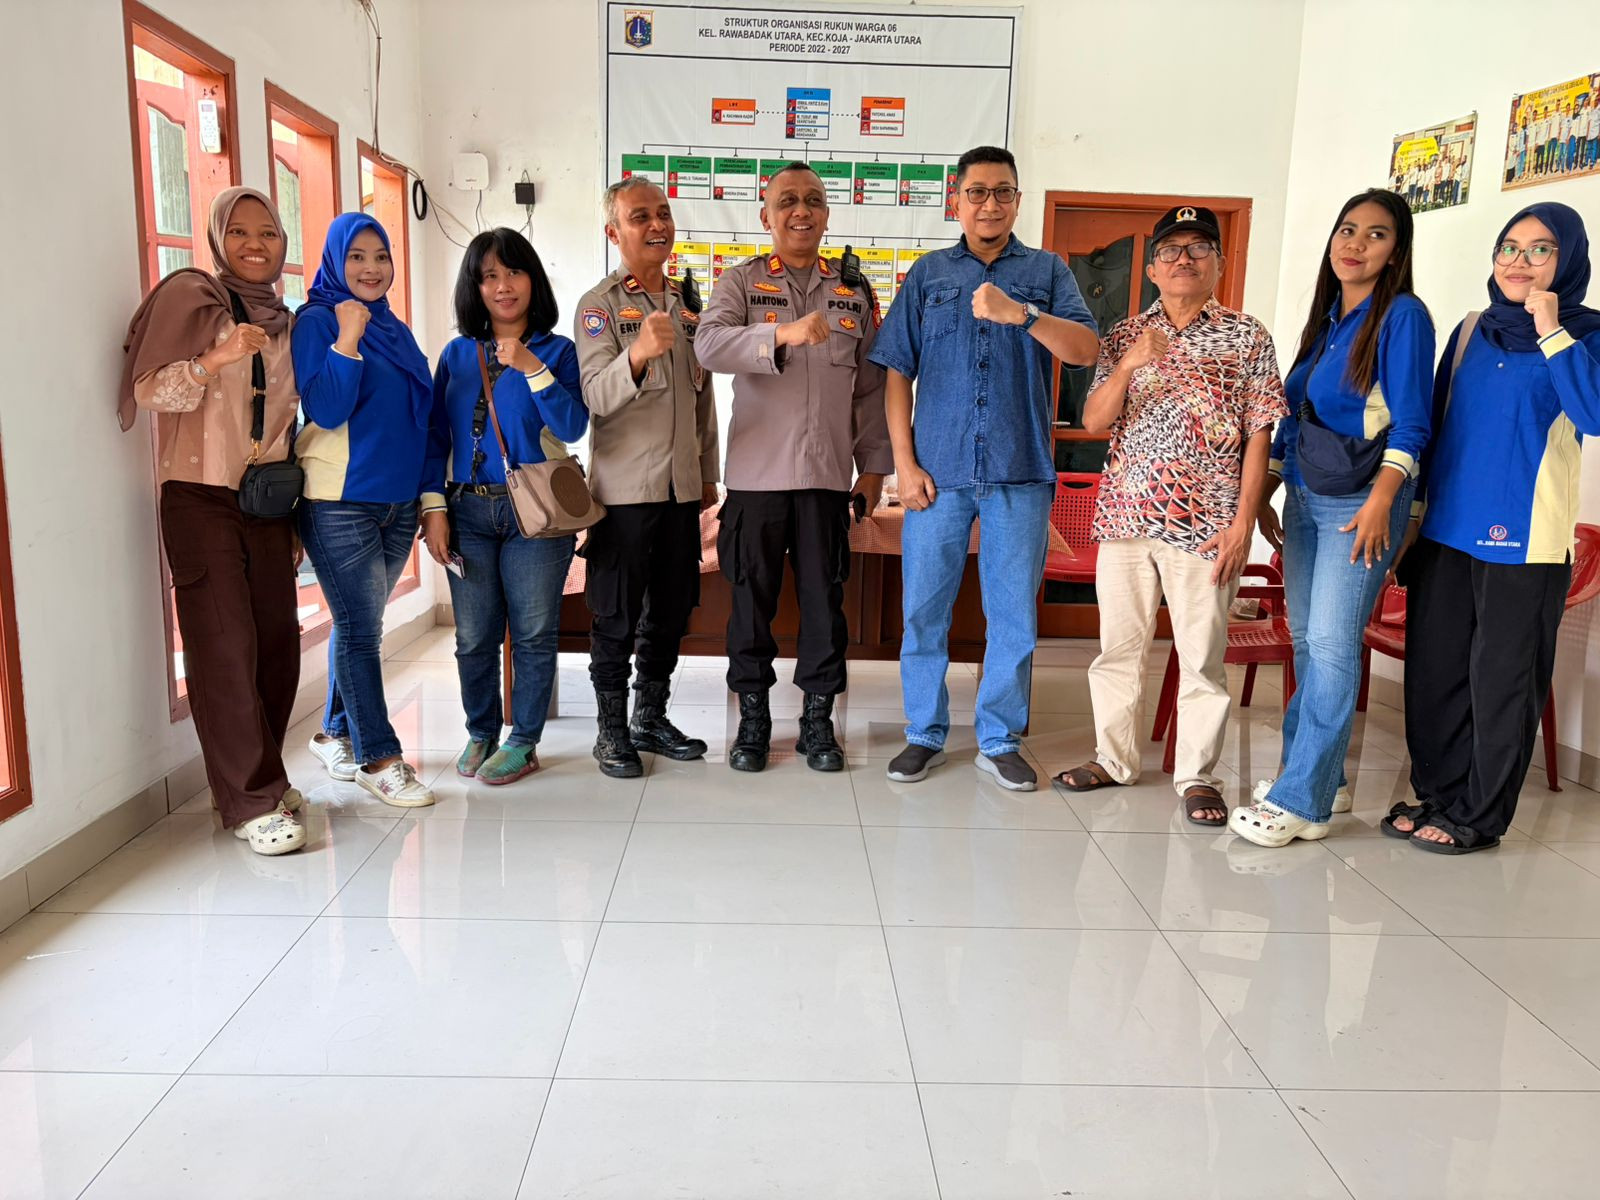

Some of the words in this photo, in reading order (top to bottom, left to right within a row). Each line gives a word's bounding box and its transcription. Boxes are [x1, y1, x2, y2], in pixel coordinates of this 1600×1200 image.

[724, 17, 769, 28] STRUKTUR
[772, 19, 822, 30] ORGANISASI
[824, 21, 853, 31] RUKUN
[855, 22, 886, 32] WARGA
[887, 23, 897, 32] 06
[698, 28, 718, 38] KEL.
[719, 29, 773, 40] RAWABADAK
[774, 31, 805, 42] UTARA,
[854, 34, 893, 44] JAKARTA
[894, 35, 922, 45] UTARA
[769, 42, 806, 53] PERIODE
[807, 44, 826, 53] 2022
[832, 45, 851, 54] 2027
[750, 294, 789, 308] HARTONO
[828, 300, 862, 314] POLRI
